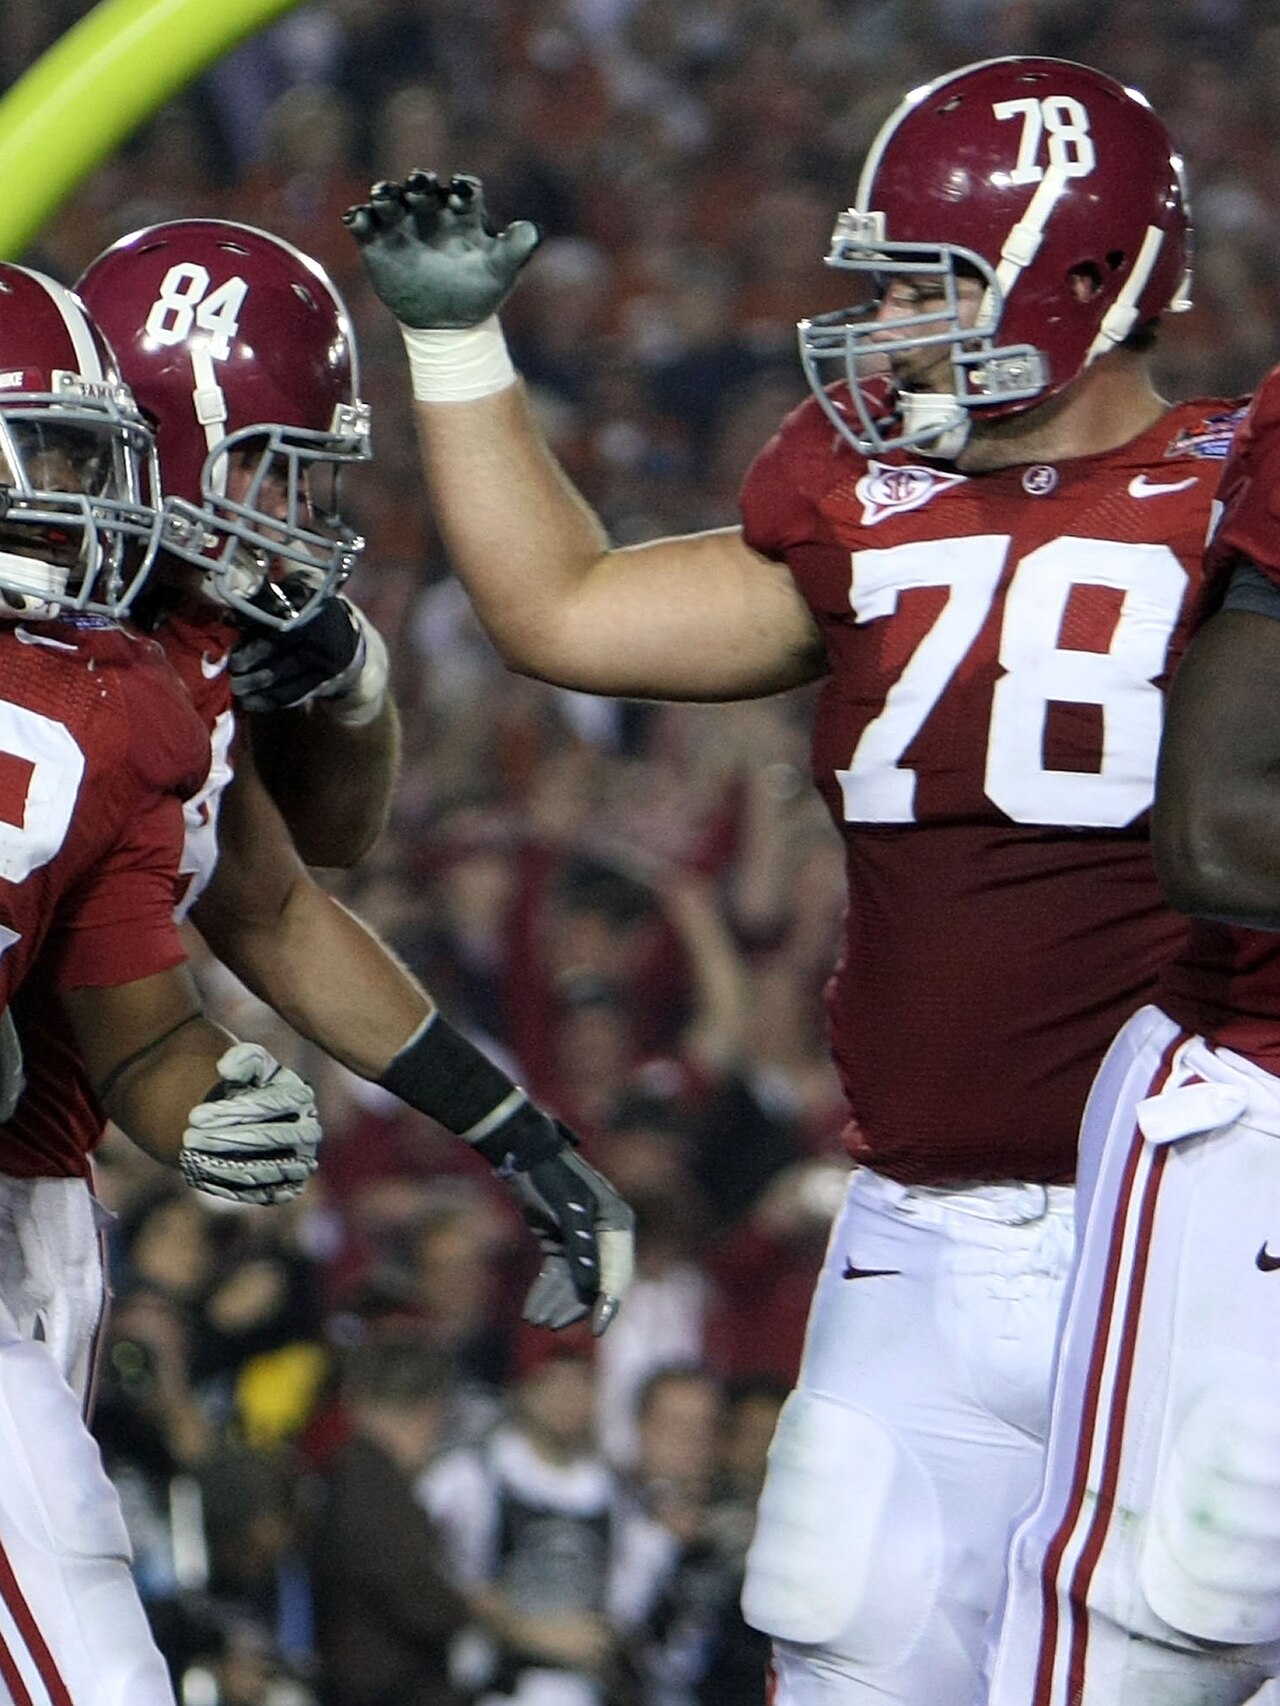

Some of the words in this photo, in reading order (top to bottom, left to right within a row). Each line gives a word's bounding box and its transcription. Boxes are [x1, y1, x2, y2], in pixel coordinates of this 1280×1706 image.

[992, 96, 1096, 185] 78
[146, 262, 249, 361] 84
[814, 534, 1190, 829] 78
